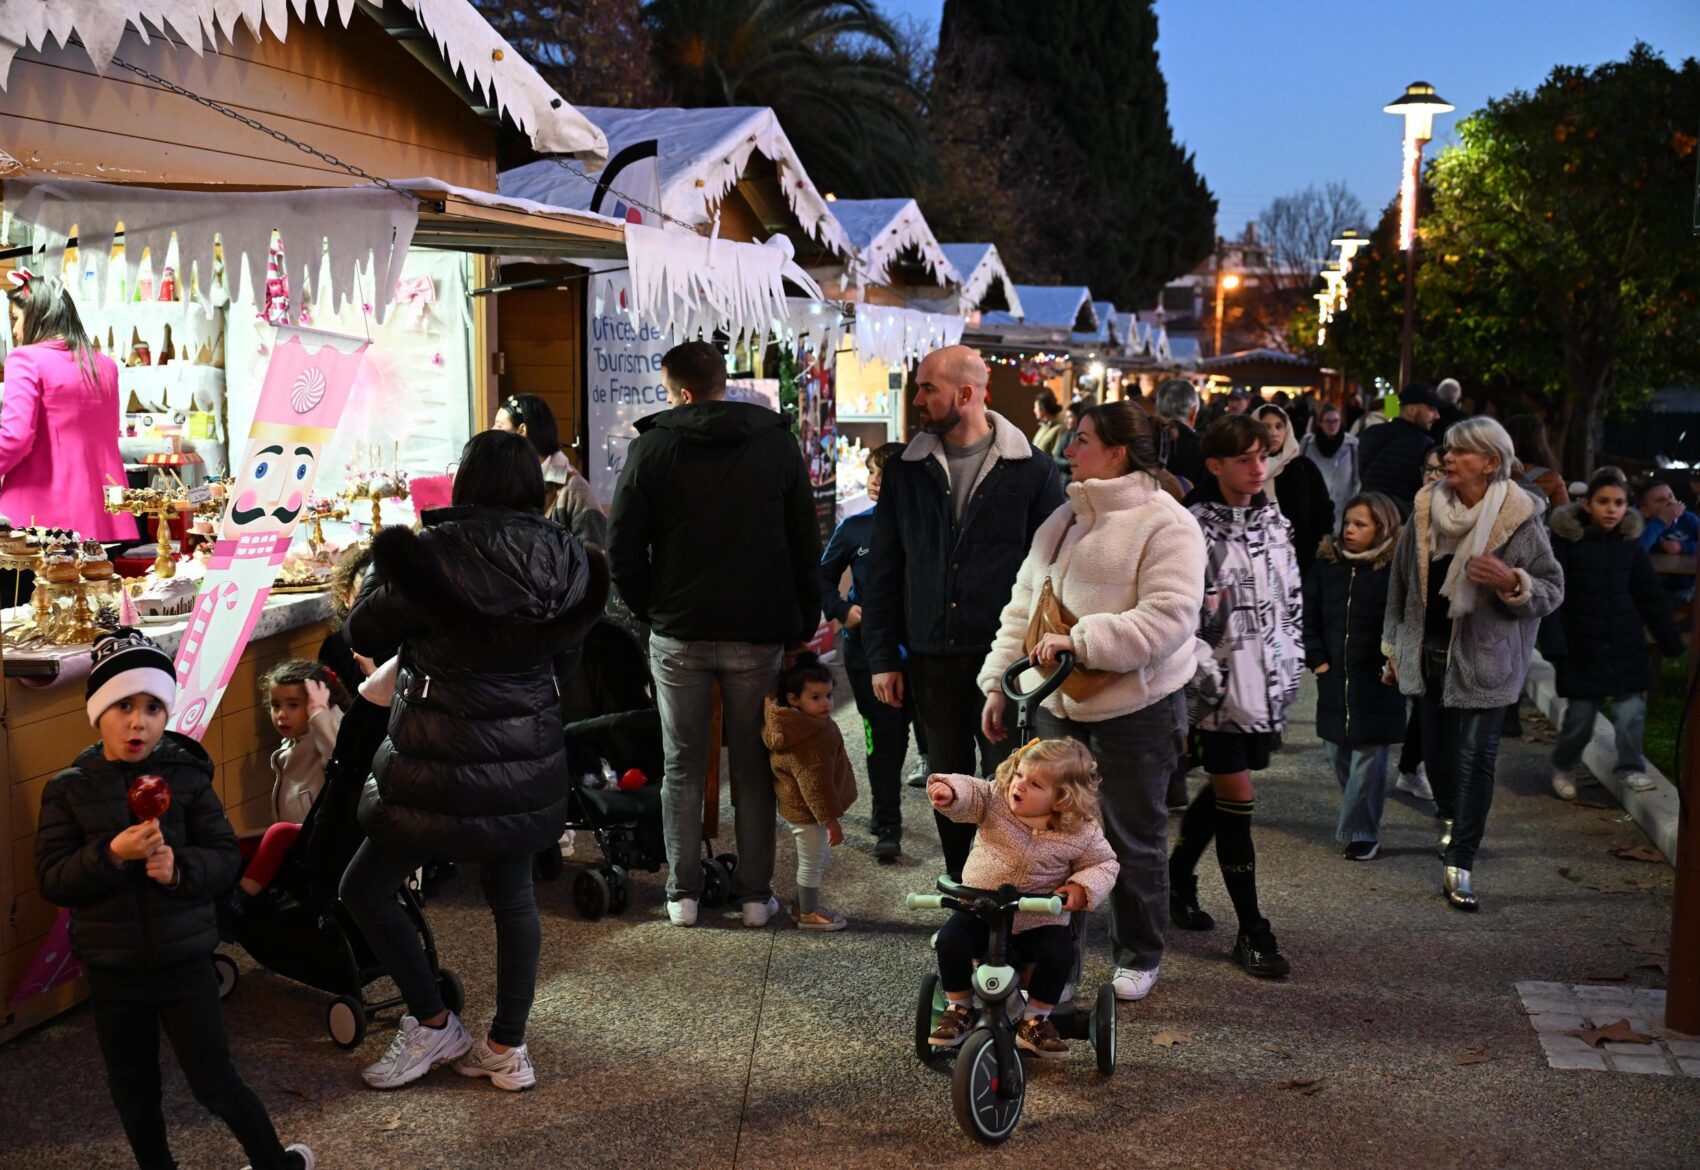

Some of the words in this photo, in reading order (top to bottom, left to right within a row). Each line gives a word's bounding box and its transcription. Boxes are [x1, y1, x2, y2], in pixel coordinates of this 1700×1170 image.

[640, 322, 661, 342] de
[593, 347, 663, 373] Tourisme
[592, 385, 606, 403] de
[610, 378, 668, 405] France
